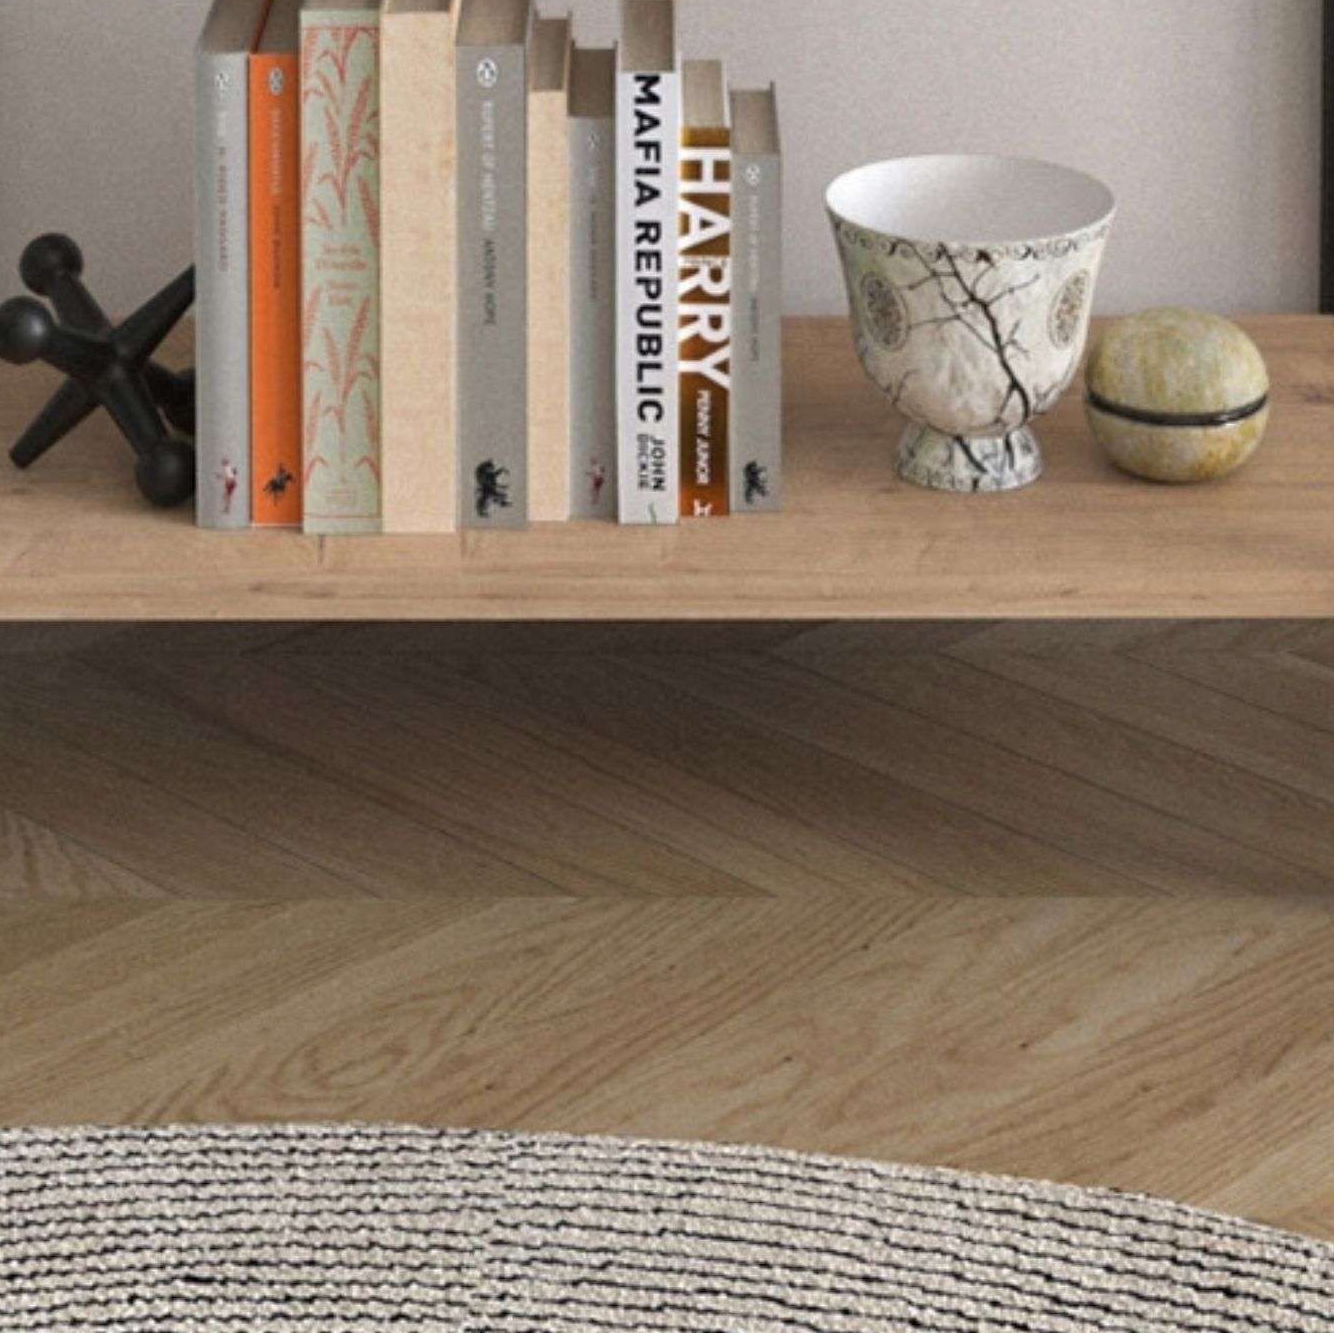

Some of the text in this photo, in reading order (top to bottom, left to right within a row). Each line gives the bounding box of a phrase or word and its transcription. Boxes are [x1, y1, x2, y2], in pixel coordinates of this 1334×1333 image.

[633, 74, 665, 423] MAFIA REPUBLIC
[677, 148, 732, 390] HARRY
[636, 433, 650, 491] DICKIE
[650, 435, 667, 493] JOHN
[695, 389, 712, 486] PENNY JUNOR
